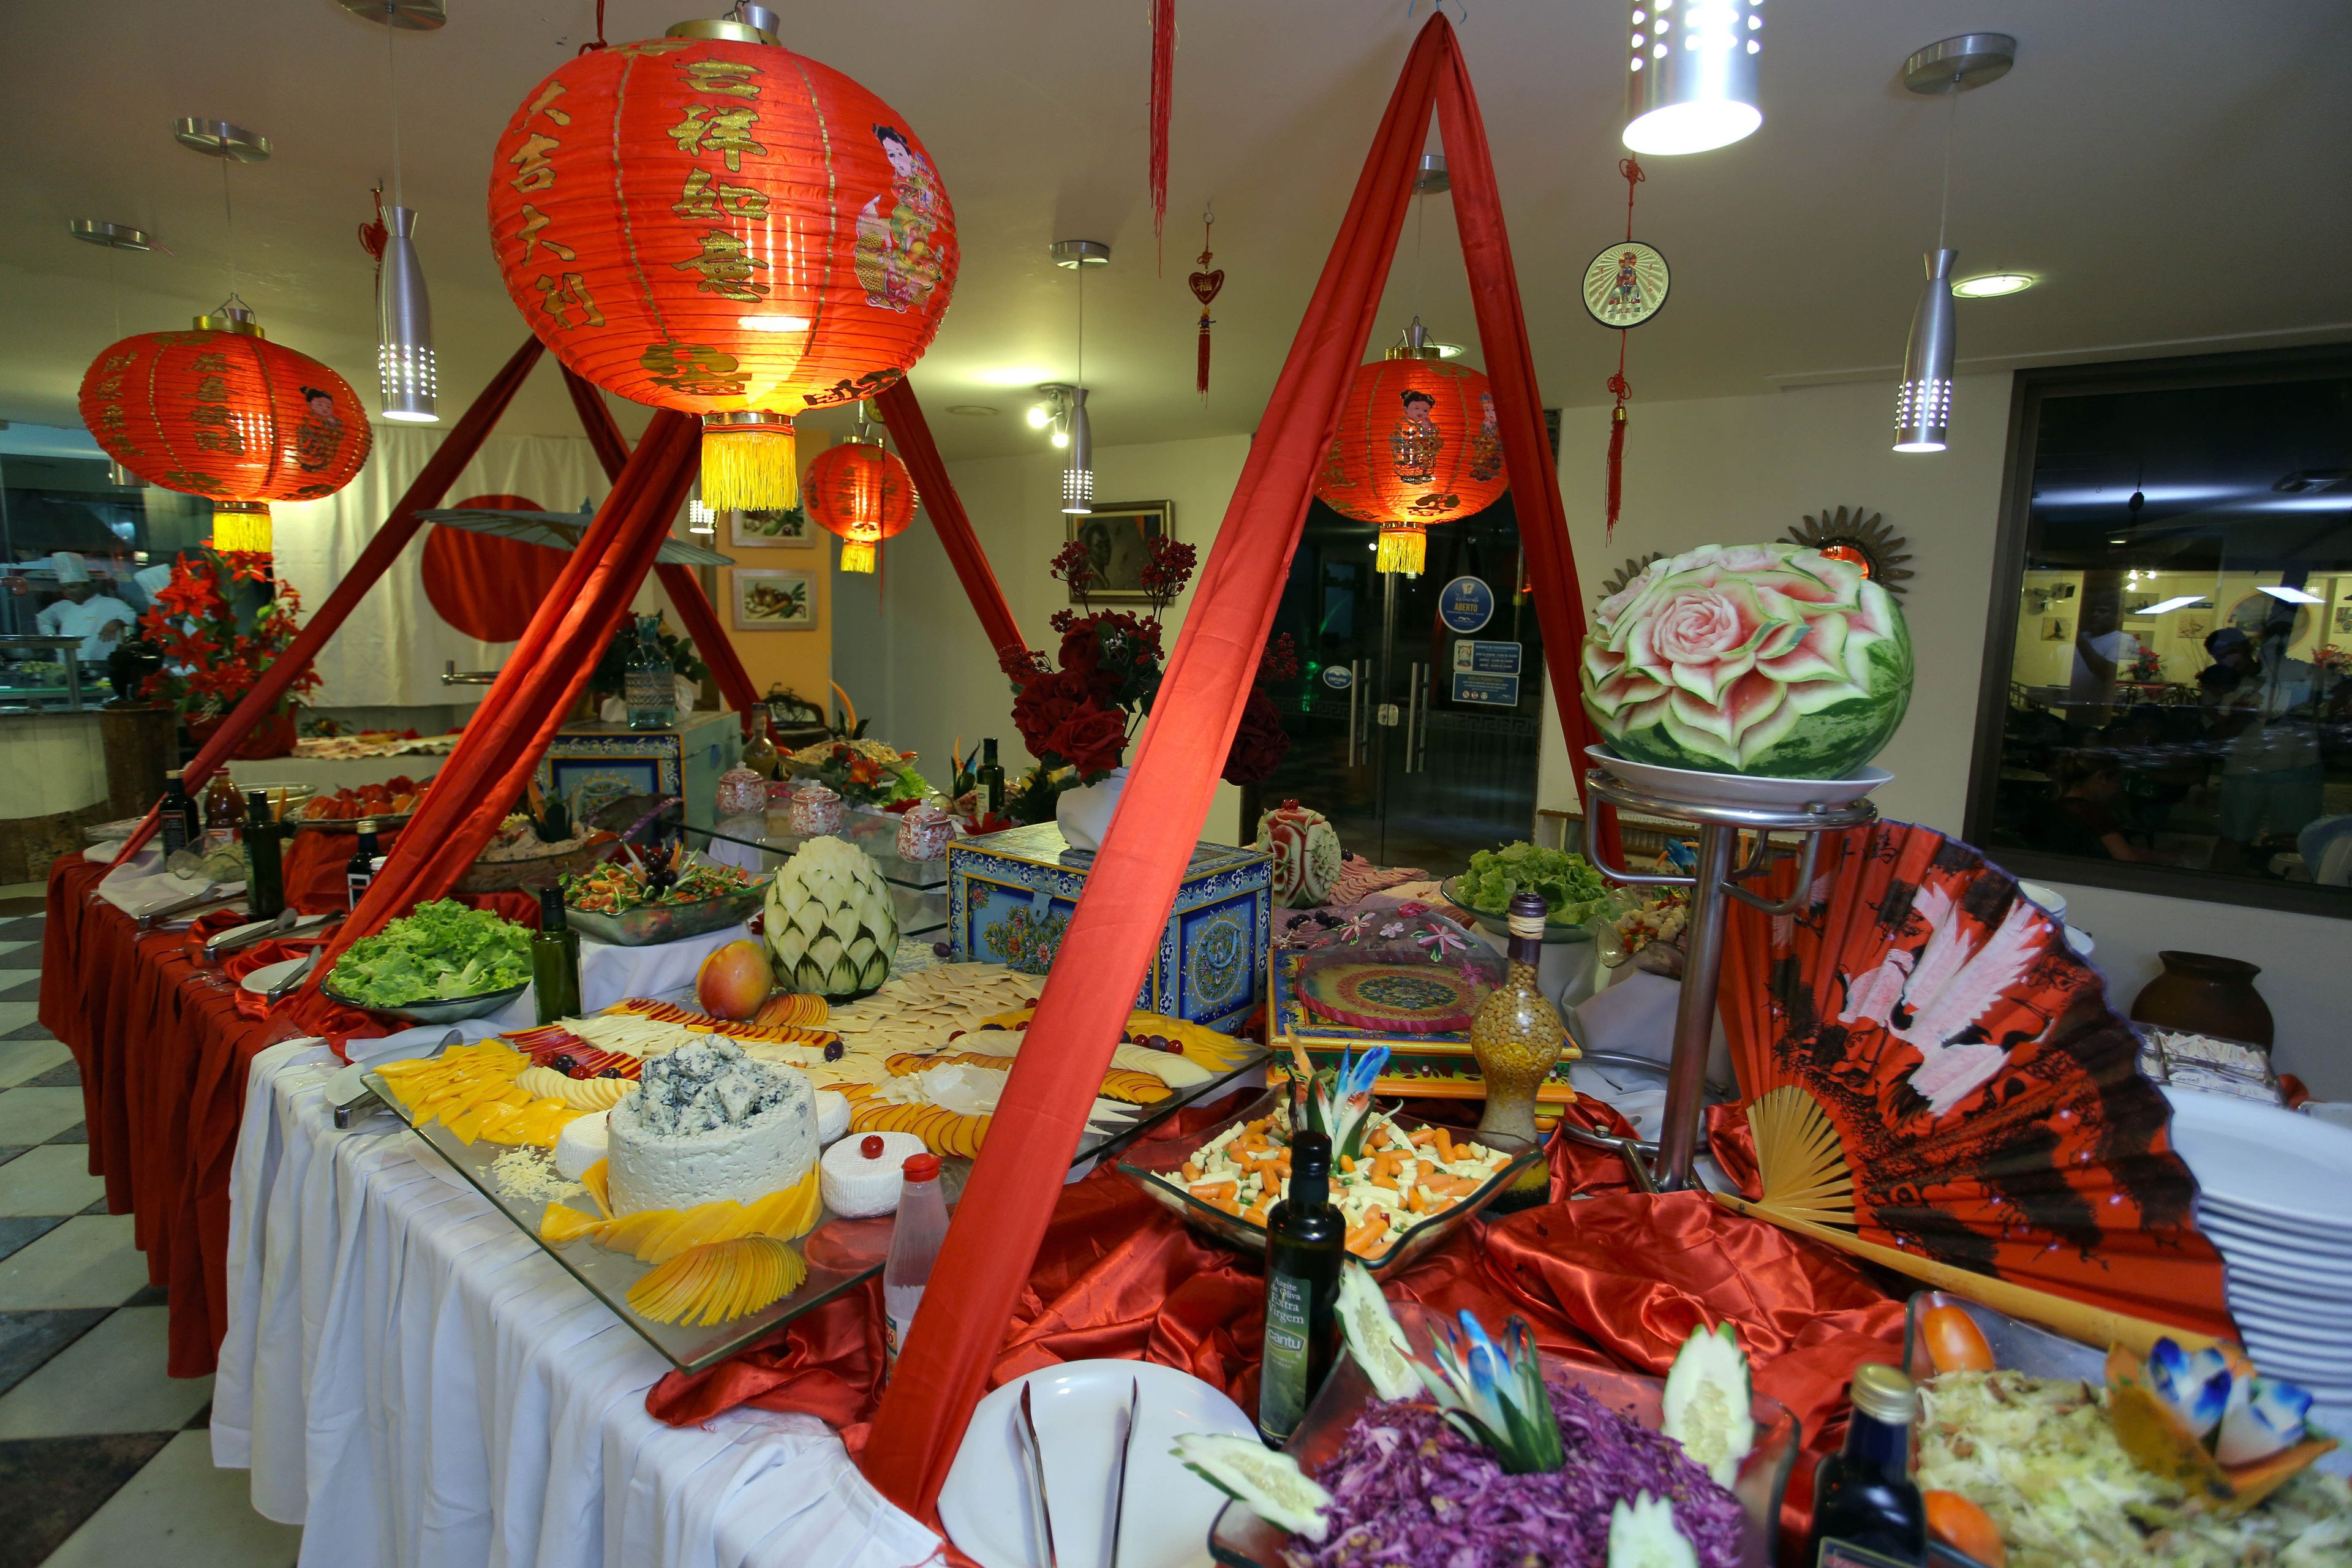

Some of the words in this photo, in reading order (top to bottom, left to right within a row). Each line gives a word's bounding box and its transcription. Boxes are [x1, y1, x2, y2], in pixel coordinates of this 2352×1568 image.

[667, 58, 769, 303] 吉祥如意
[1196, 279, 1213, 292] 福
[1454, 603, 1478, 612] ABERTO
[1271, 1284, 1278, 1292] de
[1280, 1288, 1300, 1301] Oliva
[1274, 1276, 1297, 1291] Azeite
[1272, 1292, 1299, 1312] Extra
[1268, 1299, 1304, 1324] Virgem
[1268, 1328, 1300, 1350] cantu
